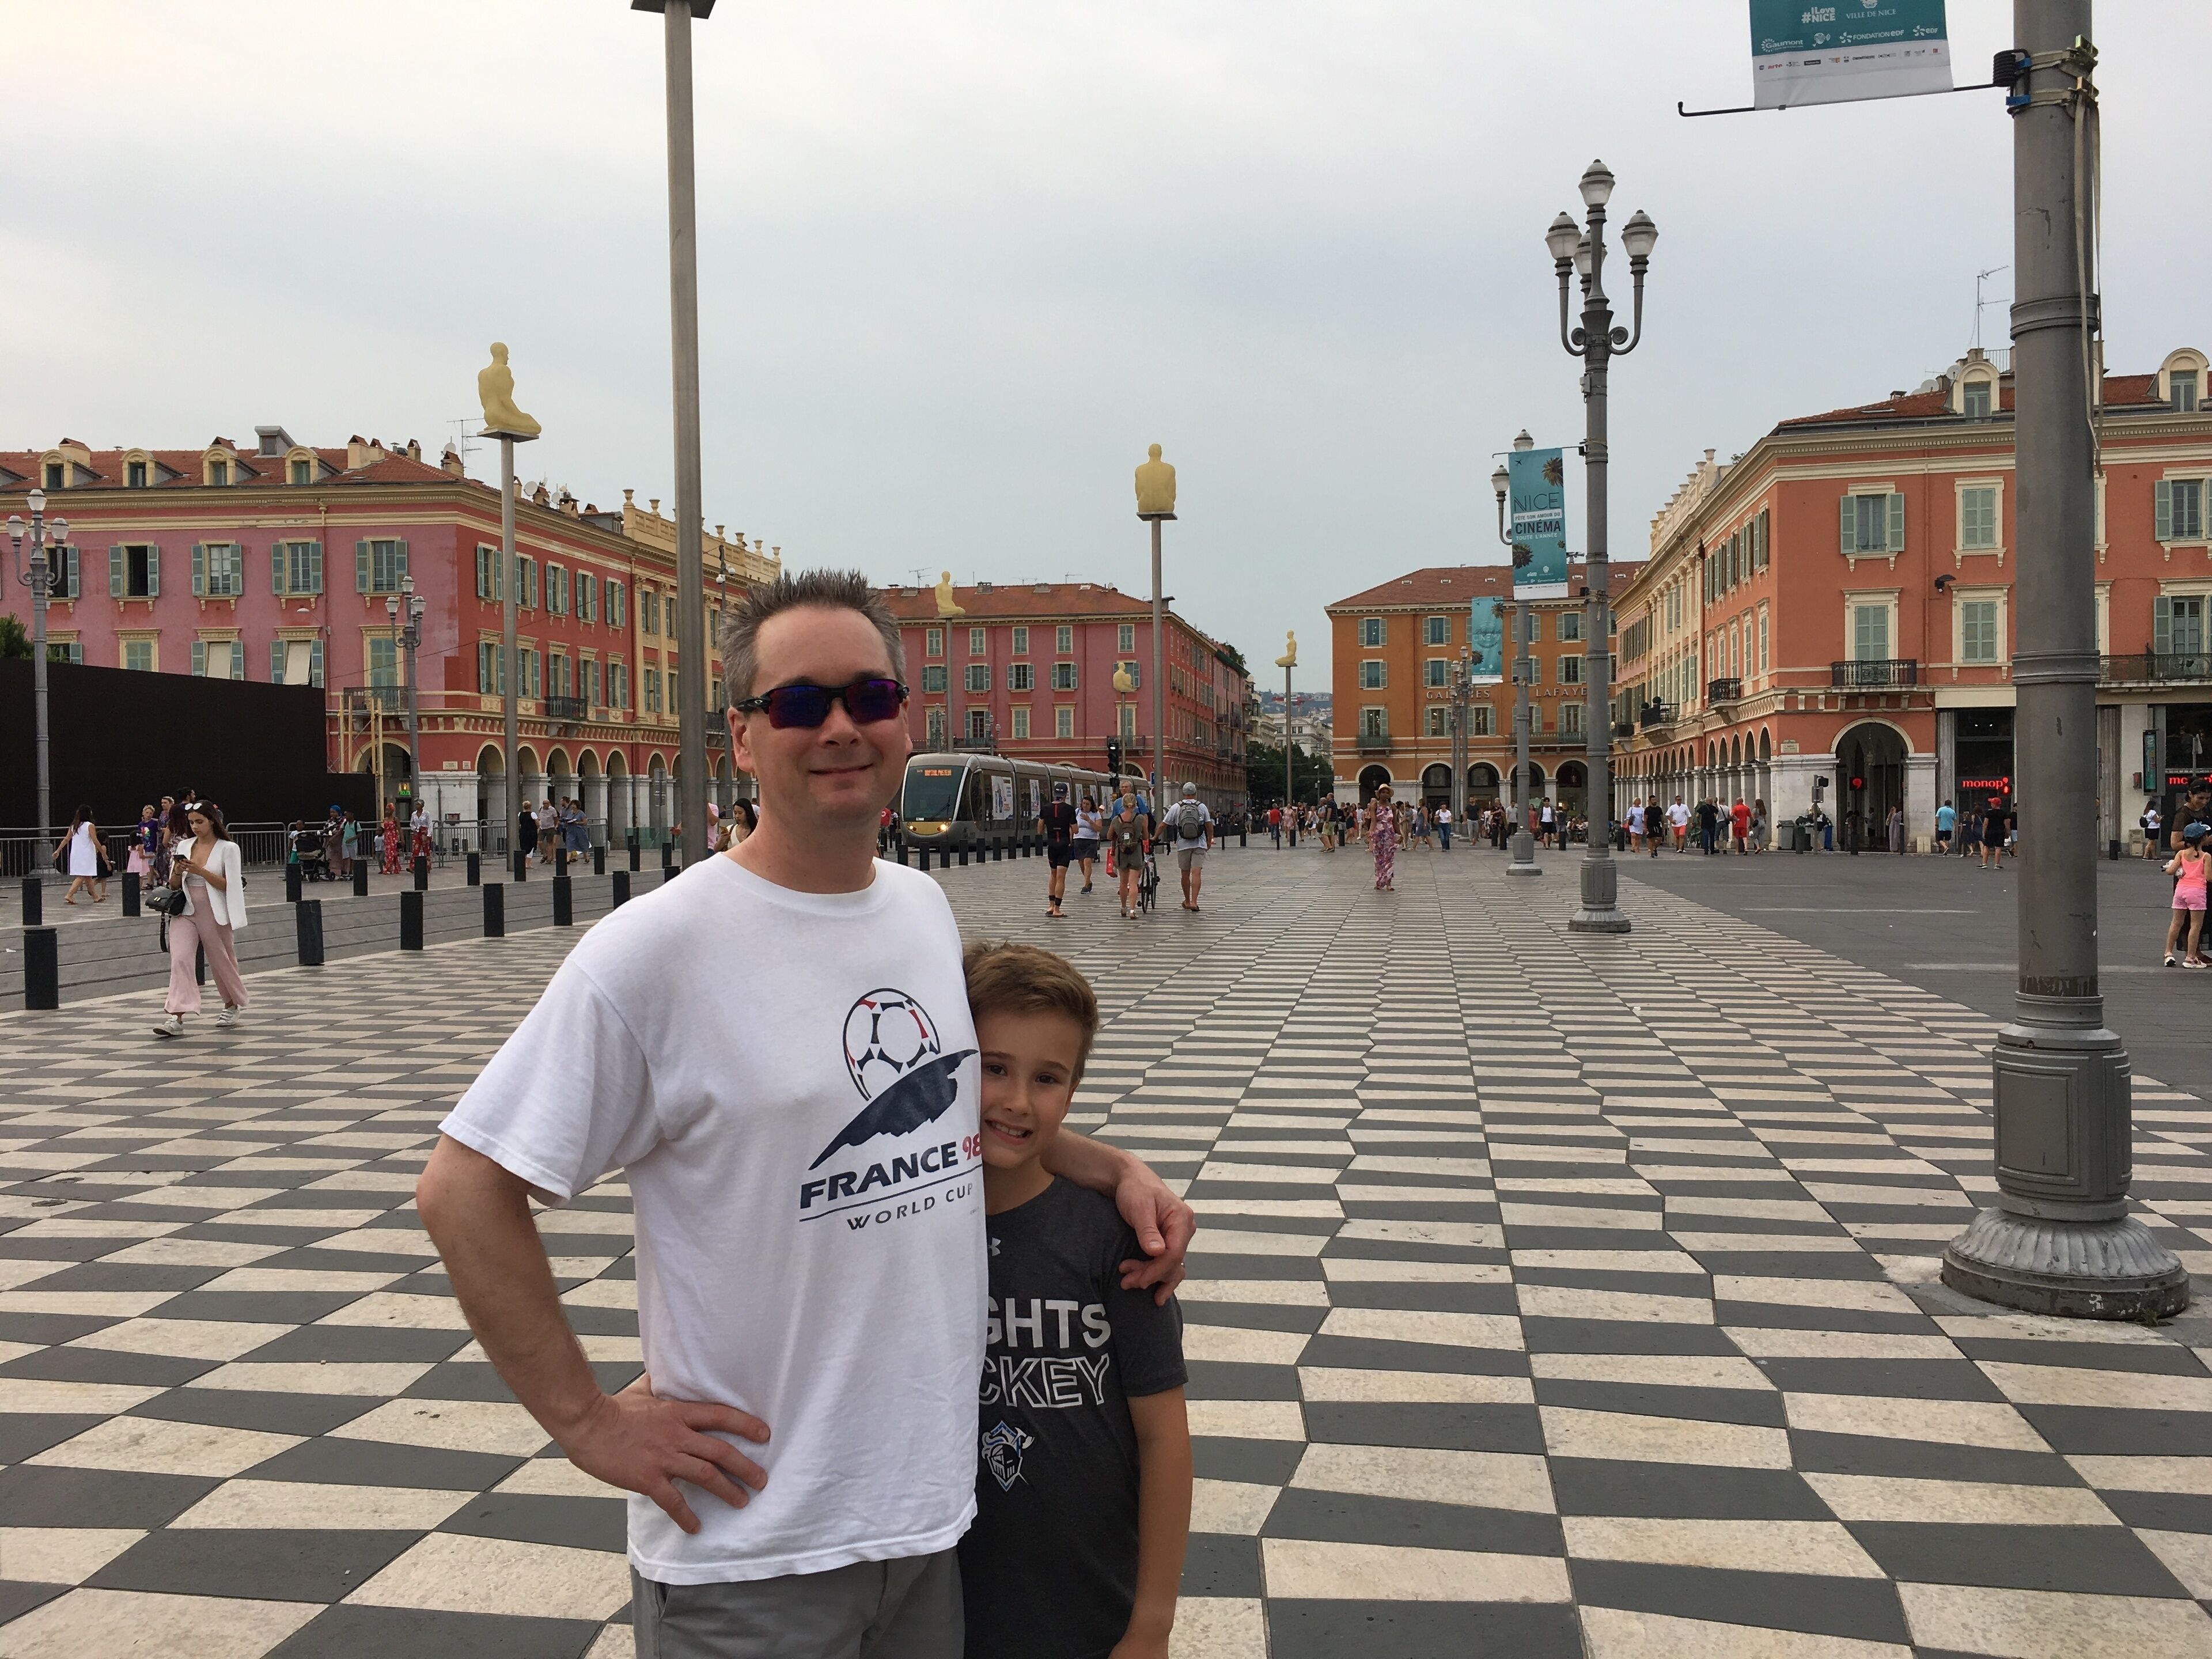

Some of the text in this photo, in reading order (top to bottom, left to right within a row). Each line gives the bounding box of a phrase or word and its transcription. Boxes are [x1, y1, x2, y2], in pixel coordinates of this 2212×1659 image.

[1766, 40, 1804, 48] Gaumont
[1853, 32, 1890, 40] FONDATION
[1514, 492, 1560, 512] NICE
[1515, 519, 1561, 534] CINÉMA
[800, 1132, 983, 1209] FRANCE 98
[847, 1182, 974, 1230] WORLD CUP
